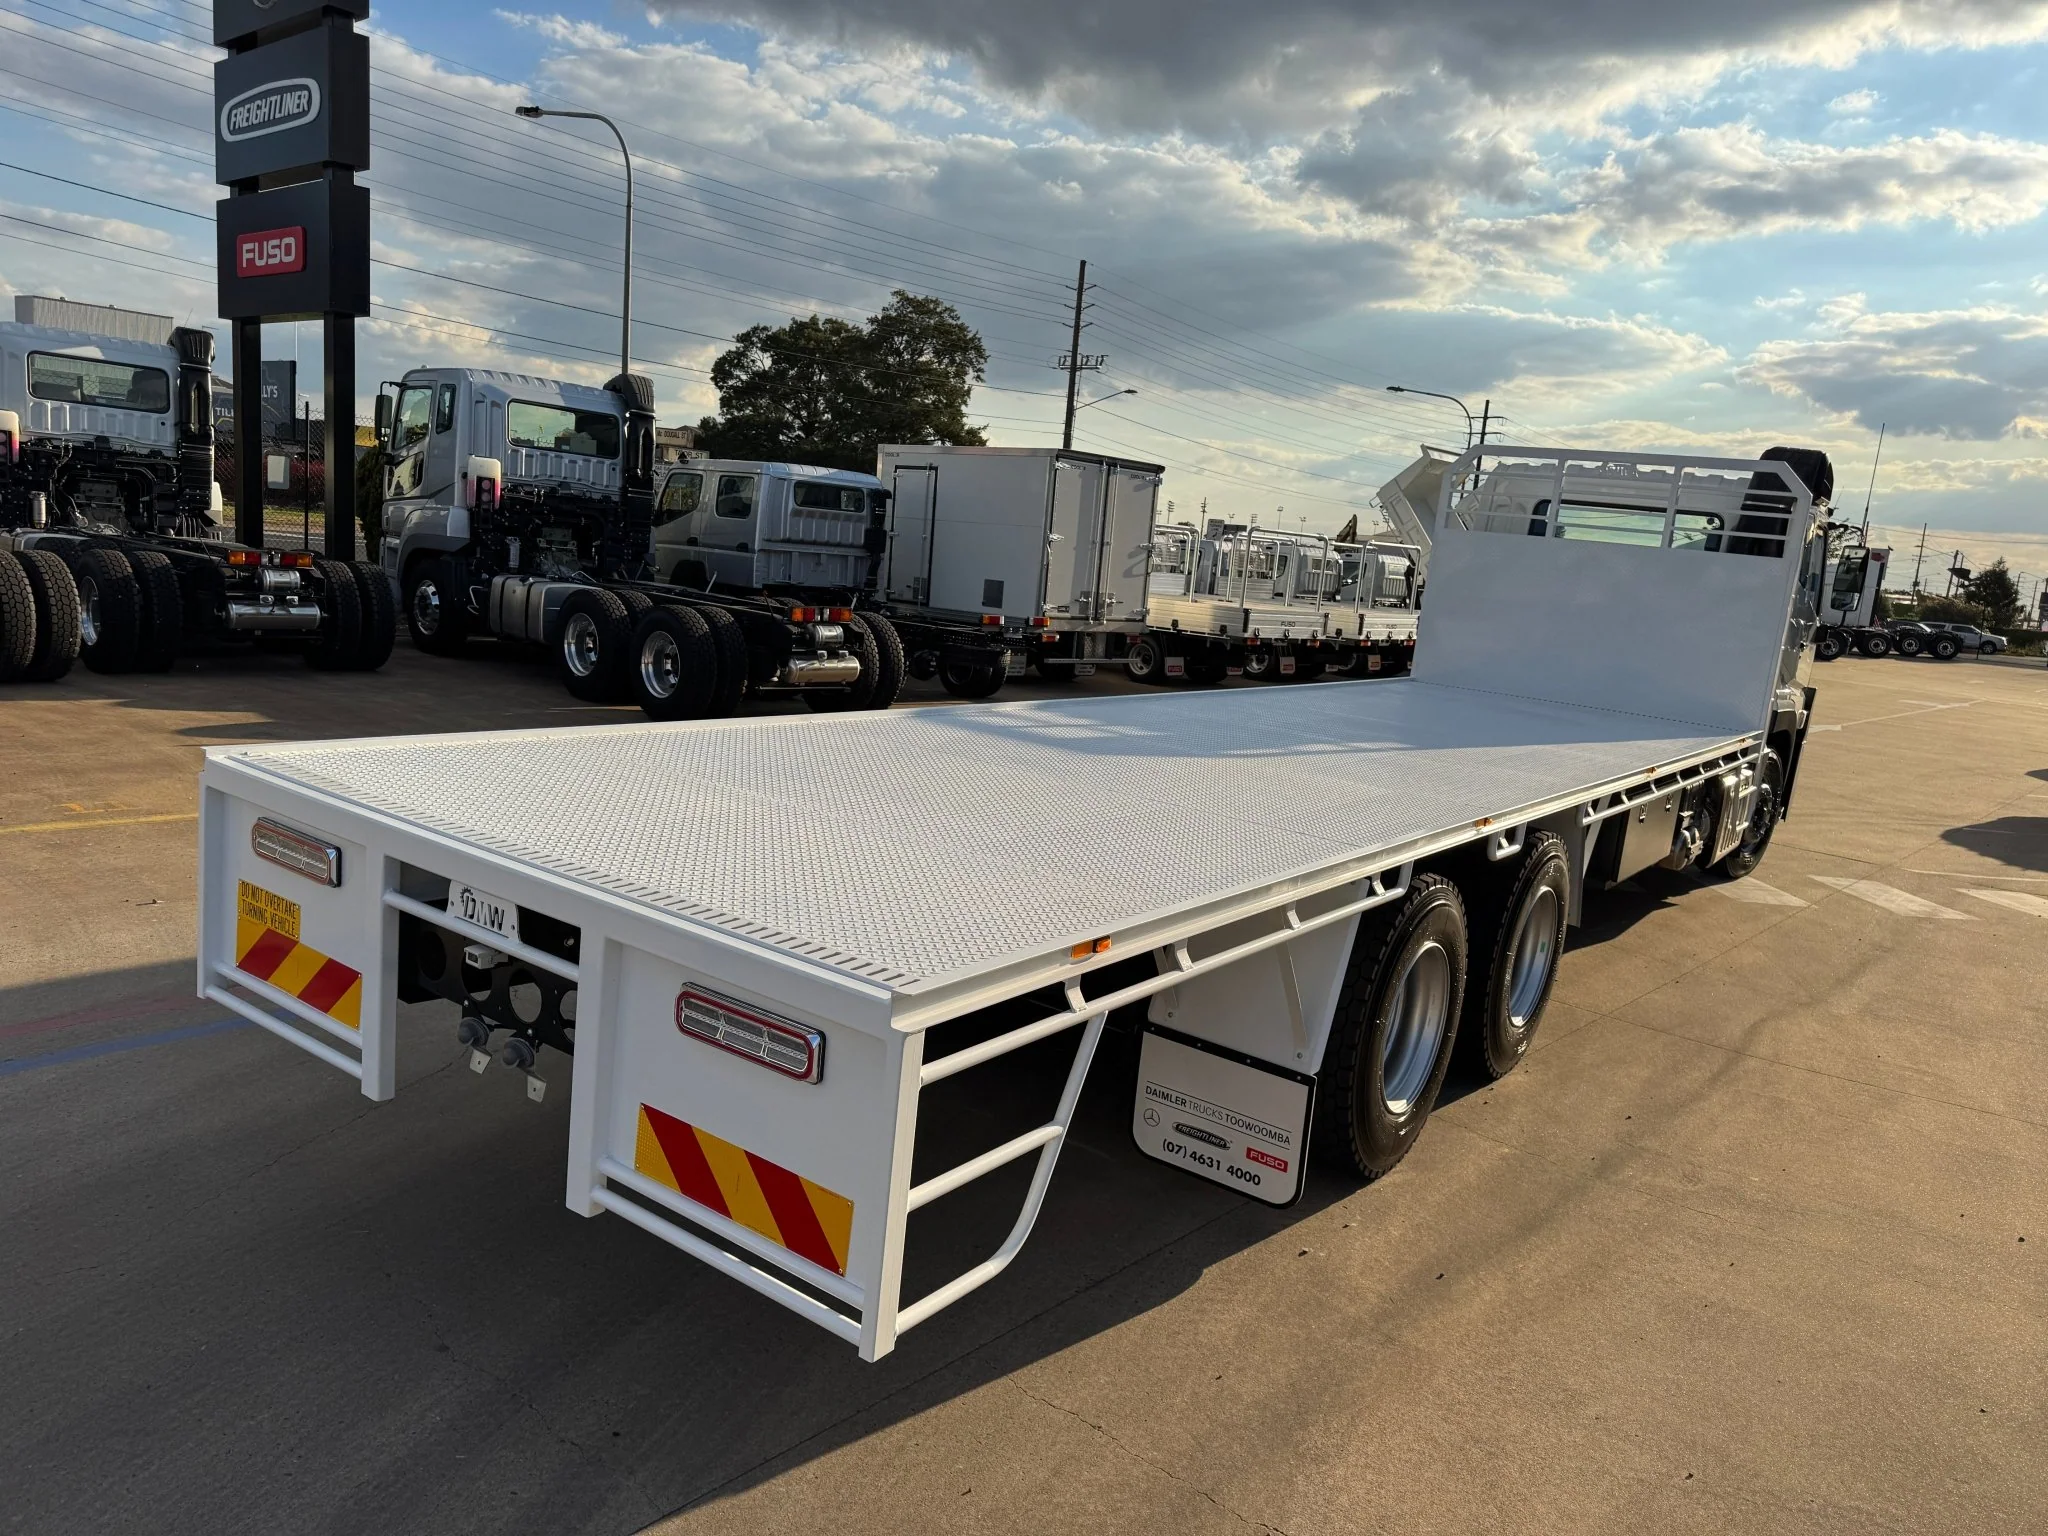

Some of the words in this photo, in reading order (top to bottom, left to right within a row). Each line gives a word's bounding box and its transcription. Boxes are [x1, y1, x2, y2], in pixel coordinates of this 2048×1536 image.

[229, 90, 310, 131] FREIGHTLINER
[242, 236, 296, 268] FUSO
[241, 881, 250, 899] DO
[251, 884, 263, 904] NOT
[264, 890, 297, 920] OVERTAKE
[241, 898, 268, 925] TURNING
[270, 912, 297, 937] VEHICLE
[463, 895, 505, 932] DMW
[1145, 1085, 1187, 1108] DAIMLER
[1188, 1100, 1223, 1120] TRUCKS
[1225, 1113, 1291, 1146] TOOWOOMBA
[1176, 1125, 1226, 1148] FREIGHTLINER
[1162, 1138, 1188, 1159] (07)
[1189, 1151, 1222, 1171] 4631
[1226, 1165, 1262, 1186] 4000
[1249, 1151, 1286, 1170] FUSO
